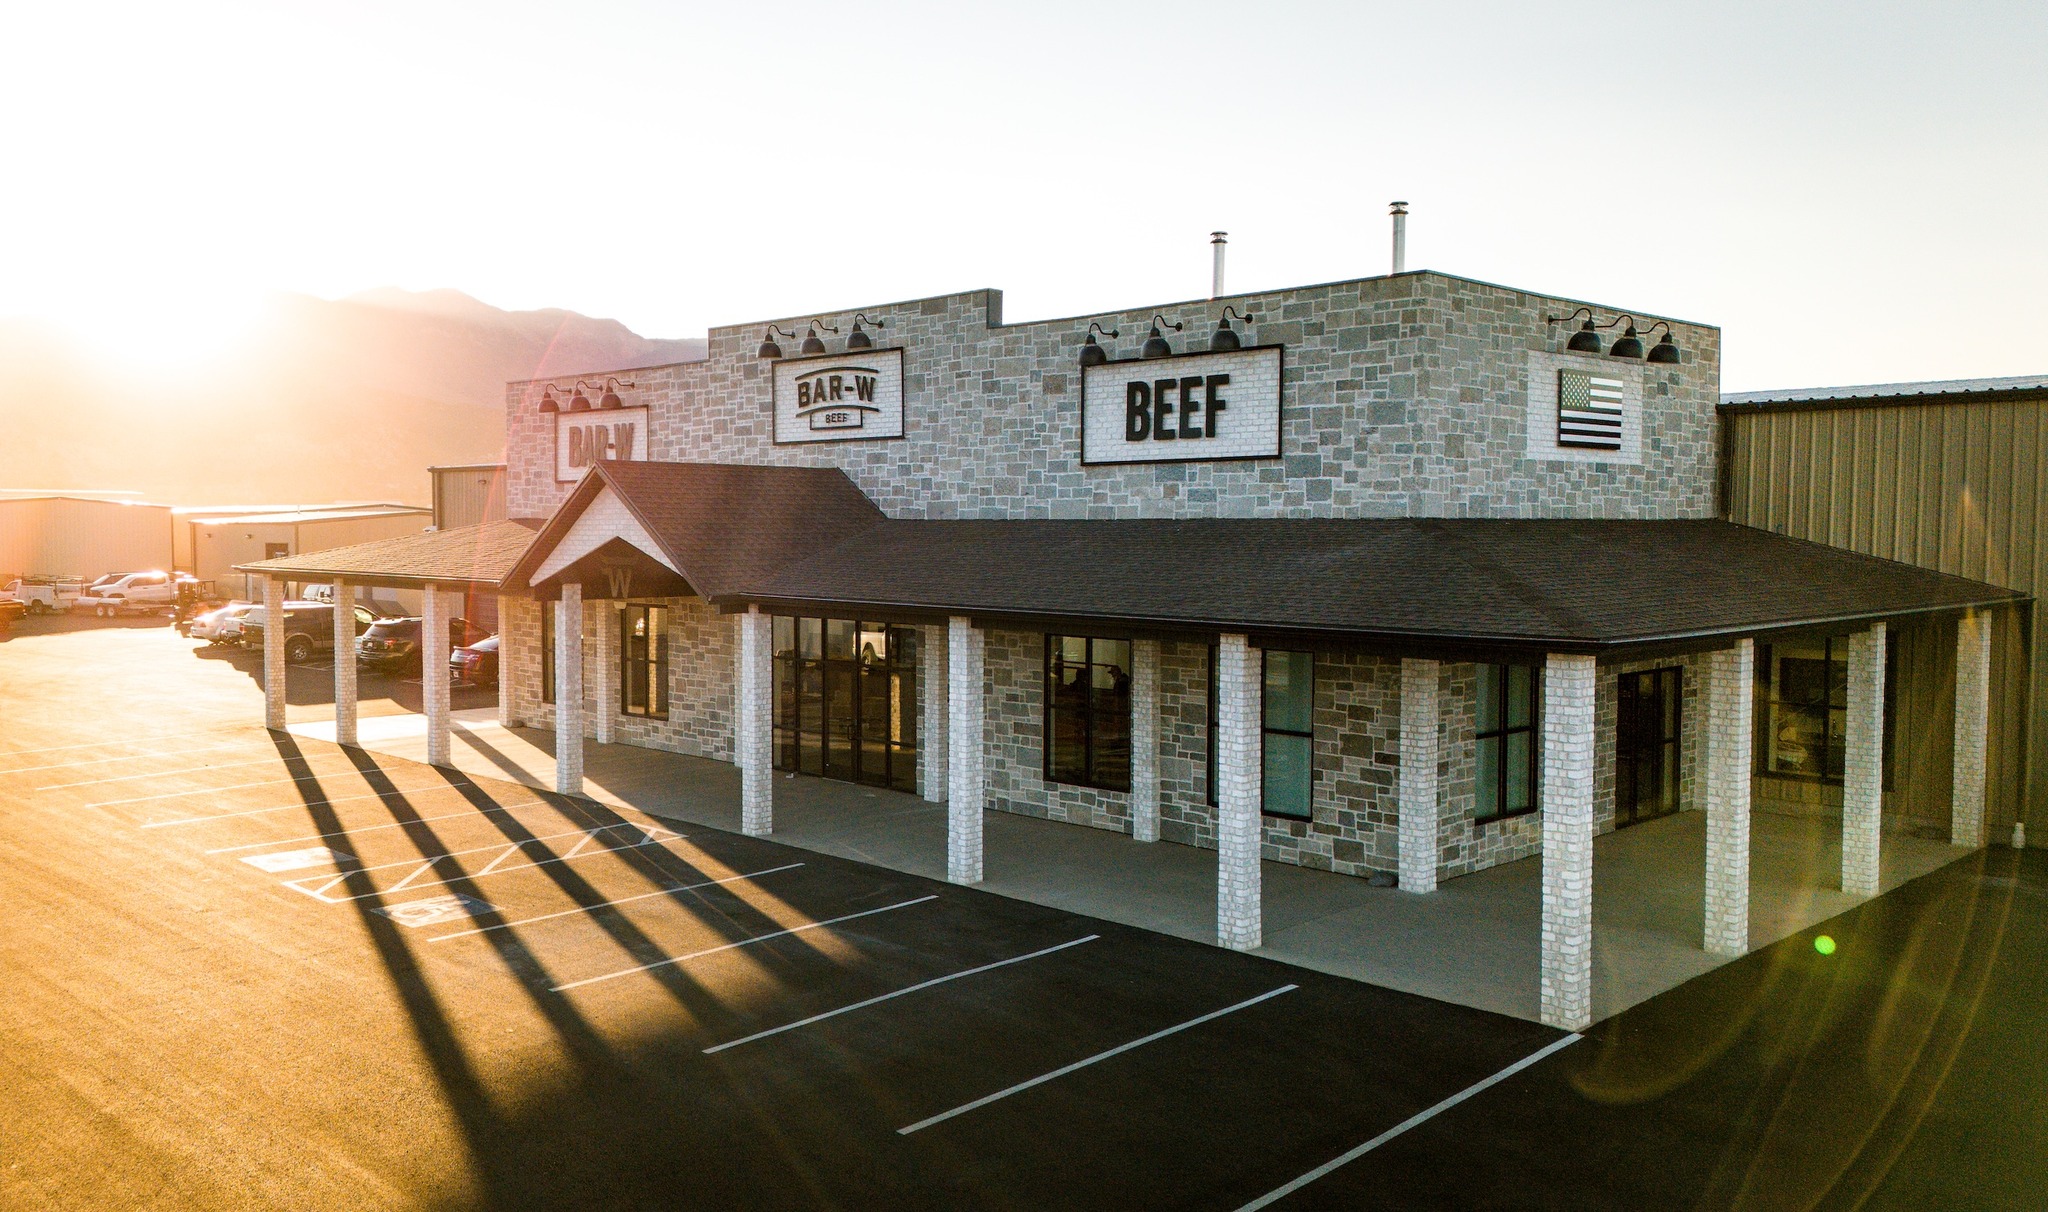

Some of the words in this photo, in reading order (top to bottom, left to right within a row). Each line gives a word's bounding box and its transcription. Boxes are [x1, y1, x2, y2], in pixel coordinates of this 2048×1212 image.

[798, 375, 876, 408] BAR-W
[1126, 374, 1230, 441] BEEF
[825, 413, 849, 424] BEEF
[603, 566, 635, 599] W
